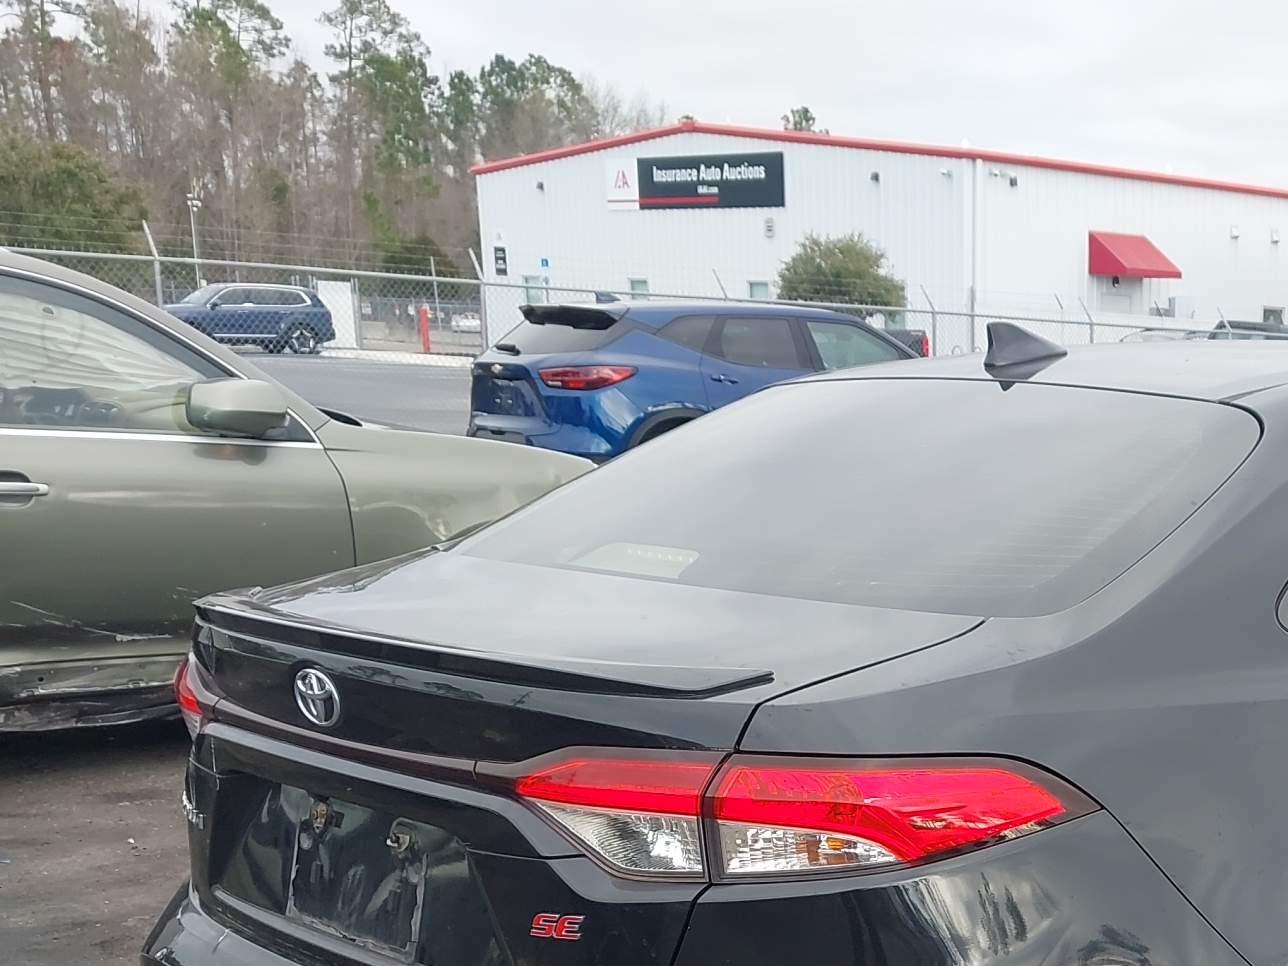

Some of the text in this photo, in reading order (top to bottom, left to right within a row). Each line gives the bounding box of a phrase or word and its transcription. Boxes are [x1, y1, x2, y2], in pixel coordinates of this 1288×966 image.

[652, 162, 766, 182] Insurance Auto Auctions
[529, 912, 586, 941] SE
